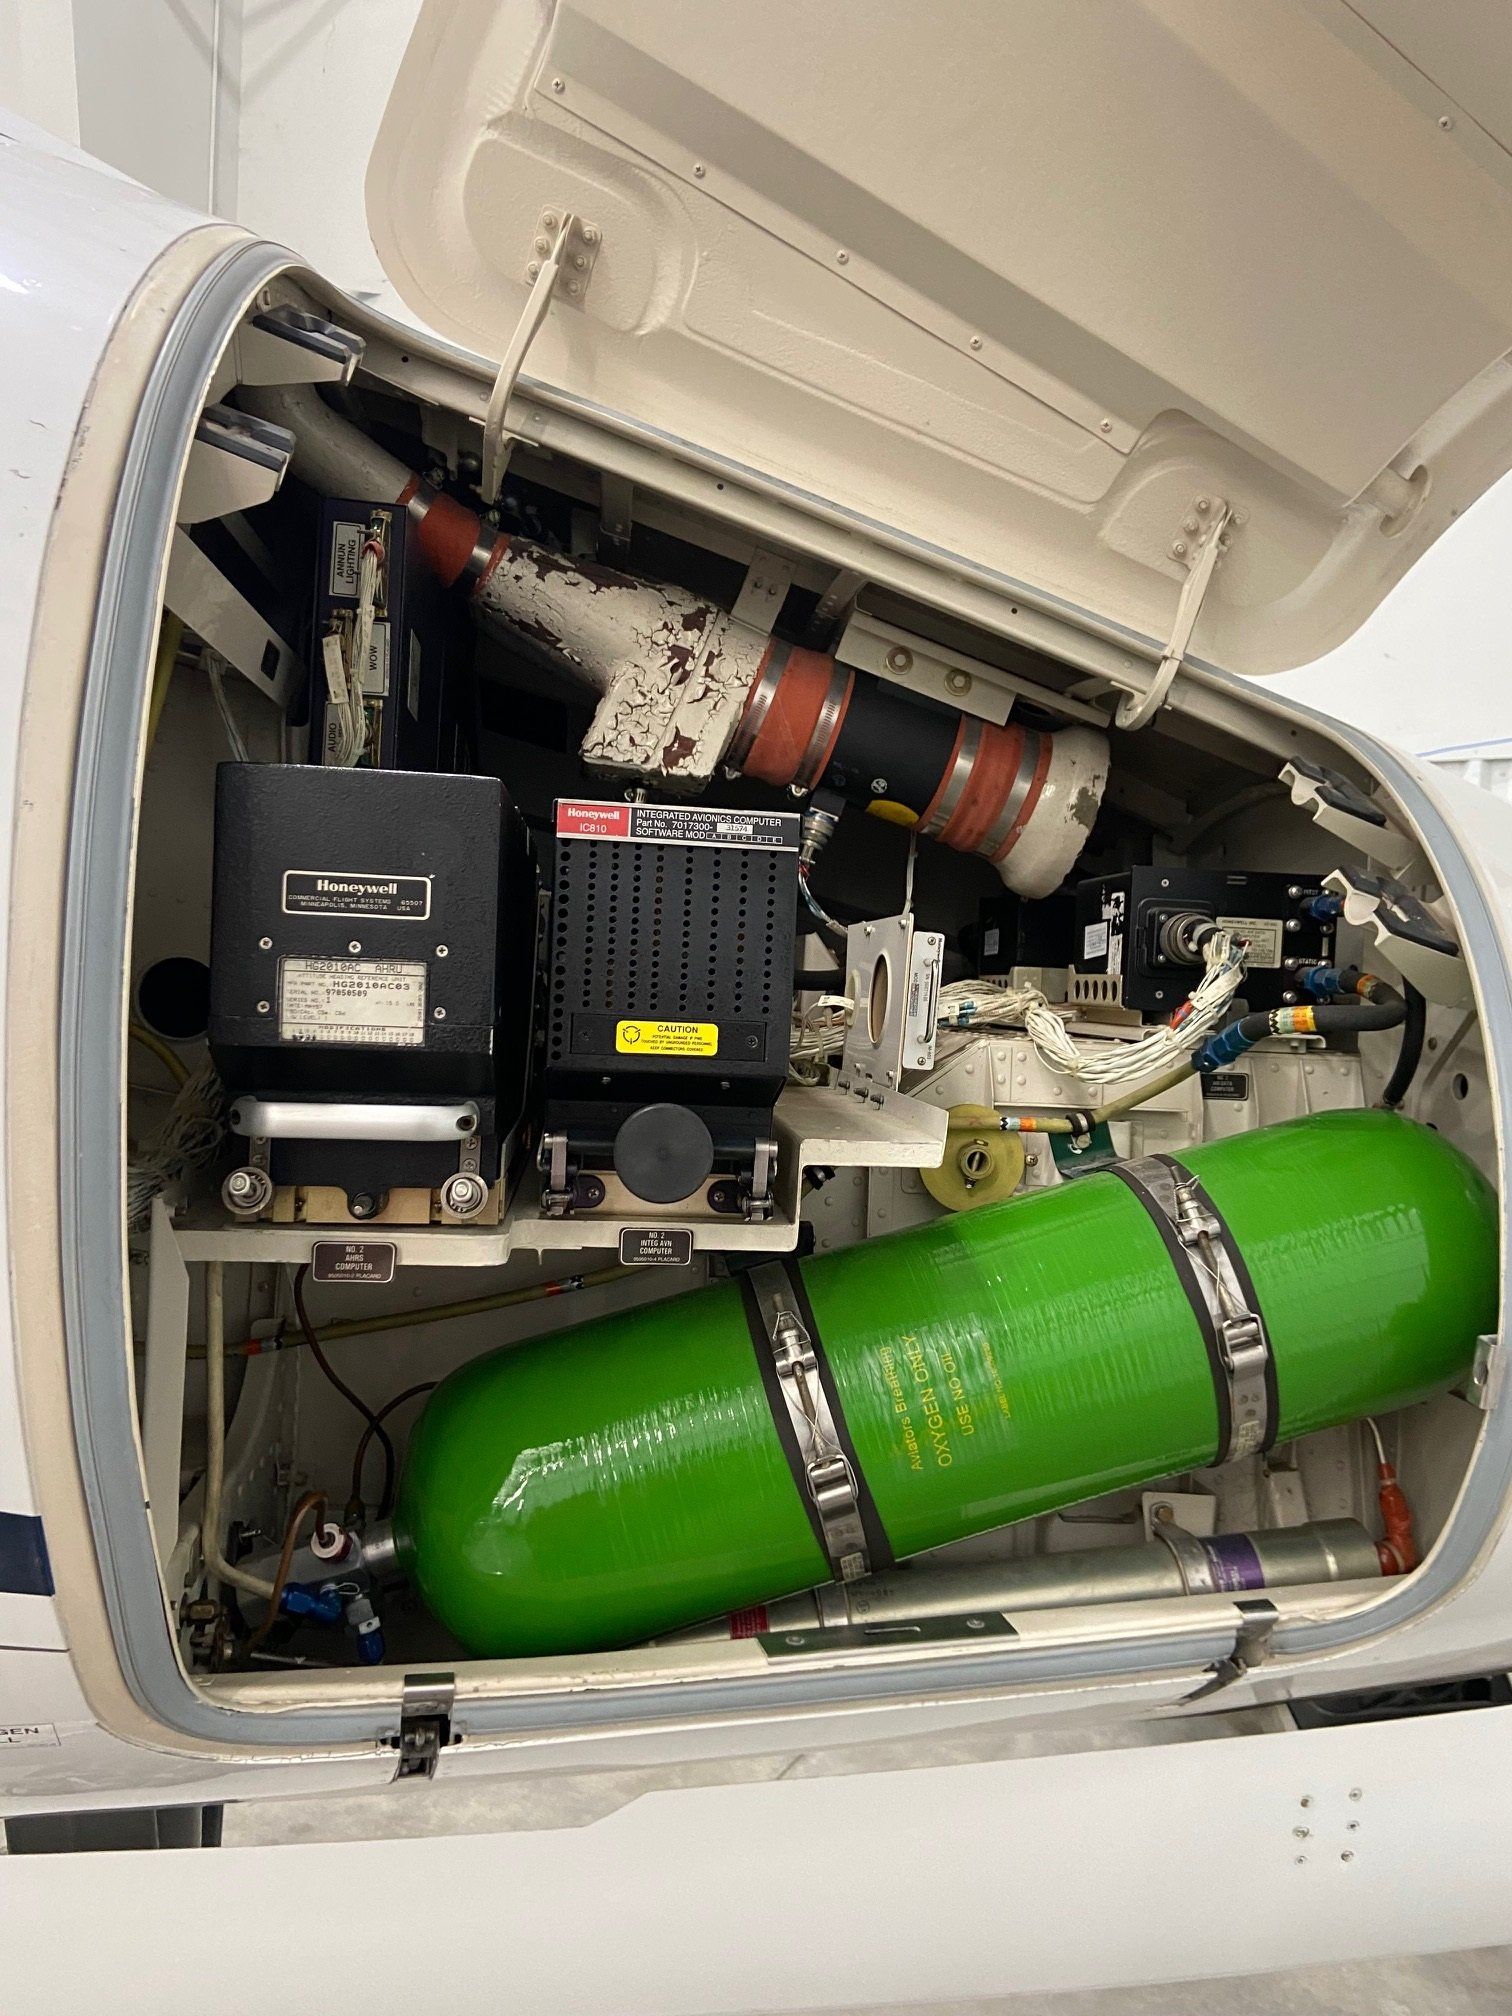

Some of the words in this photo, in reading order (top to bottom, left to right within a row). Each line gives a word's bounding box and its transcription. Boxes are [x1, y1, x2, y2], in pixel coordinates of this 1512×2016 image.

[336, 543, 346, 578] ANNUN
[345, 539, 356, 584] LIGHTING
[369, 645, 378, 671] WOW
[328, 722, 336, 753] AUDIO
[567, 807, 620, 820] Honeywell
[636, 809, 691, 820] INTEGRATED
[691, 813, 732, 824] AVIONICS
[733, 815, 782, 827] COMPUTER
[579, 822, 607, 833] IC810
[636, 818, 652, 827] Part
[654, 820, 668, 828] No.
[672, 821, 713, 831] 7017300-
[635, 827, 684, 838] SOFTWARE
[685, 830, 706, 839] MOD
[317, 879, 398, 895] Honeywell
[288, 894, 331, 902] COMMERCIAL
[305, 960, 361, 972] HG2010AC
[374, 963, 403, 974] AHRU
[333, 981, 411, 991] HG2010AC03
[657, 1024, 699, 1034] CAUTION
[640, 1239, 659, 1247] INTEG
[345, 1254, 364, 1262] AHRS
[639, 1247, 673, 1255] COMPUTER
[335, 1263, 373, 1271] COMPUTER
[901, 1336, 929, 1383] ONLY
[880, 1346, 908, 1413] Breathing
[949, 1377, 965, 1401] NO
[920, 1387, 953, 1467] OXYGEN
[955, 1403, 975, 1436] USE
[902, 1416, 924, 1470] Aviators
